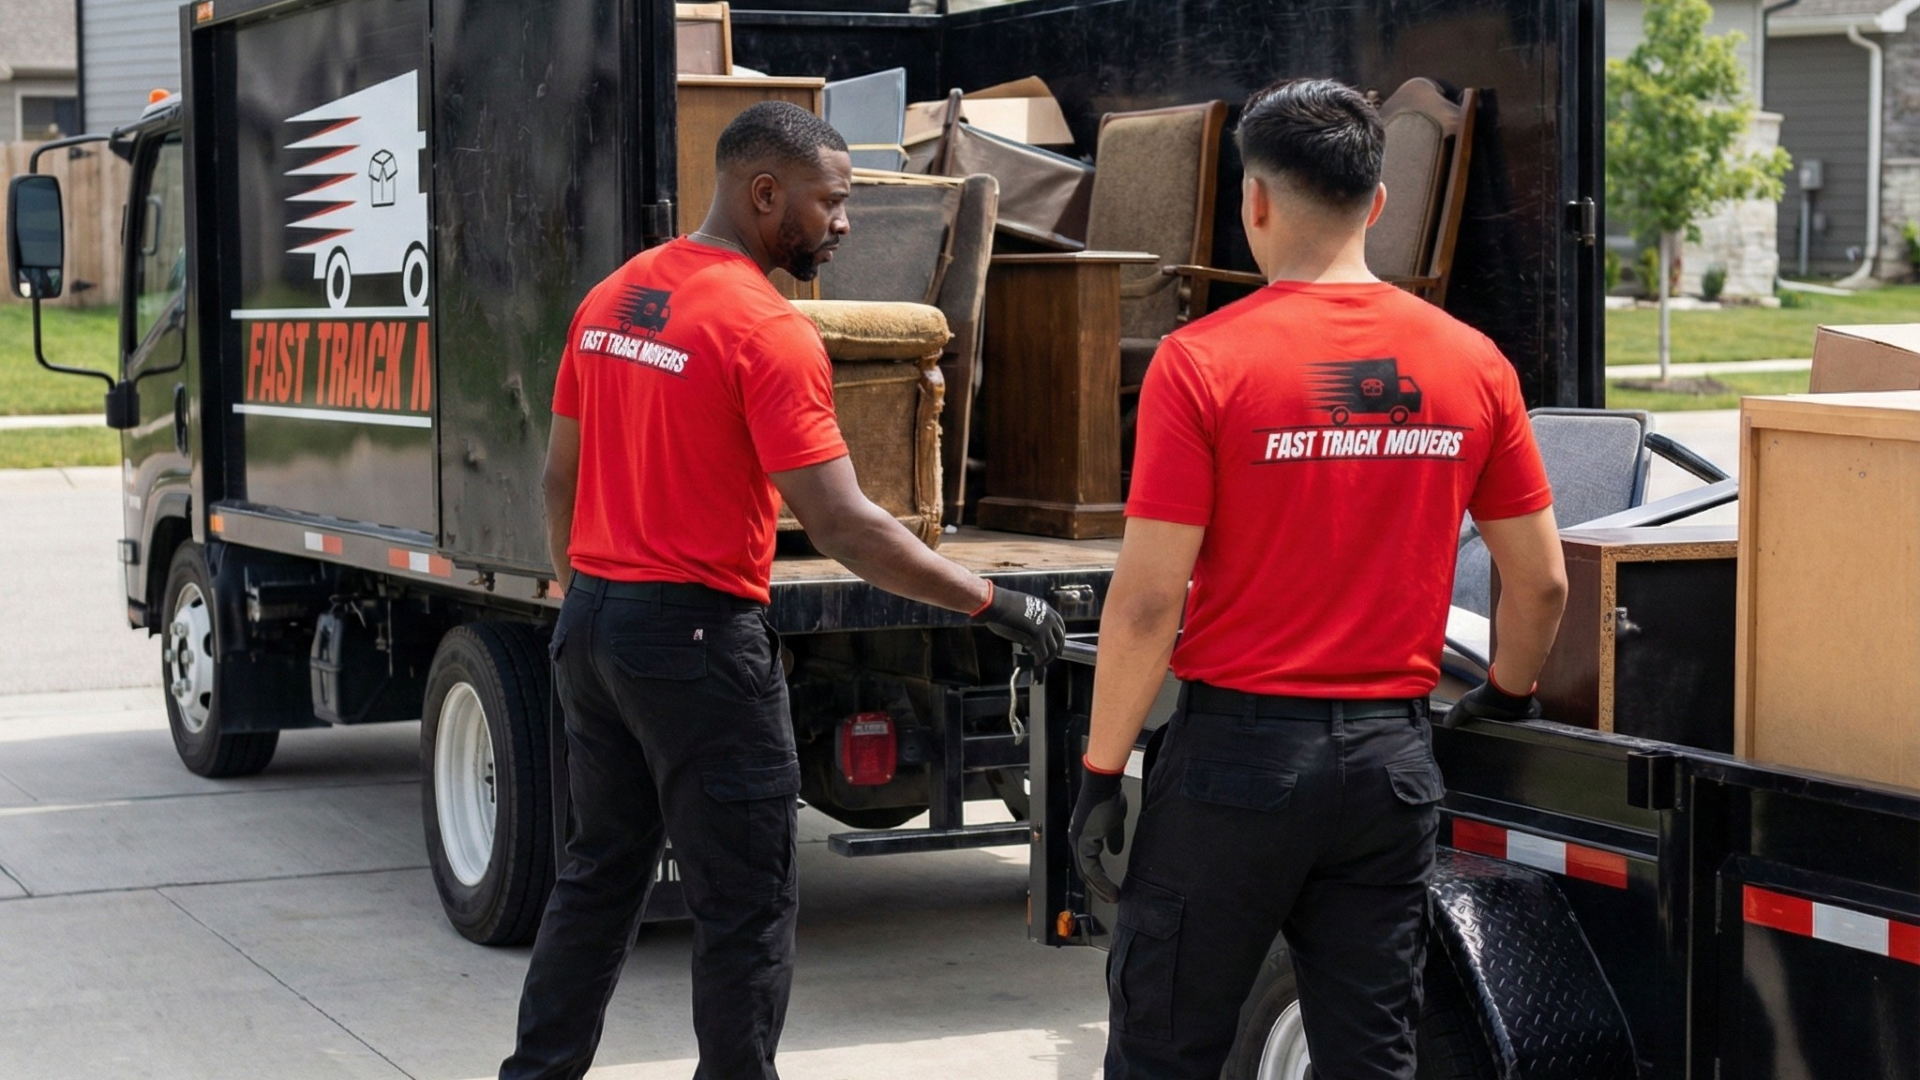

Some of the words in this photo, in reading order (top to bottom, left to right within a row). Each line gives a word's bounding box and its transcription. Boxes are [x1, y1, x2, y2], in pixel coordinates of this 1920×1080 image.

[247, 322, 310, 404] FAST
[316, 322, 407, 410] TRACK
[580, 330, 607, 351] FAST
[638, 341, 689, 373] MOVERS
[1265, 430, 1317, 459] FAST
[1321, 429, 1382, 456] TRACK
[1383, 429, 1464, 457] MOVERS
